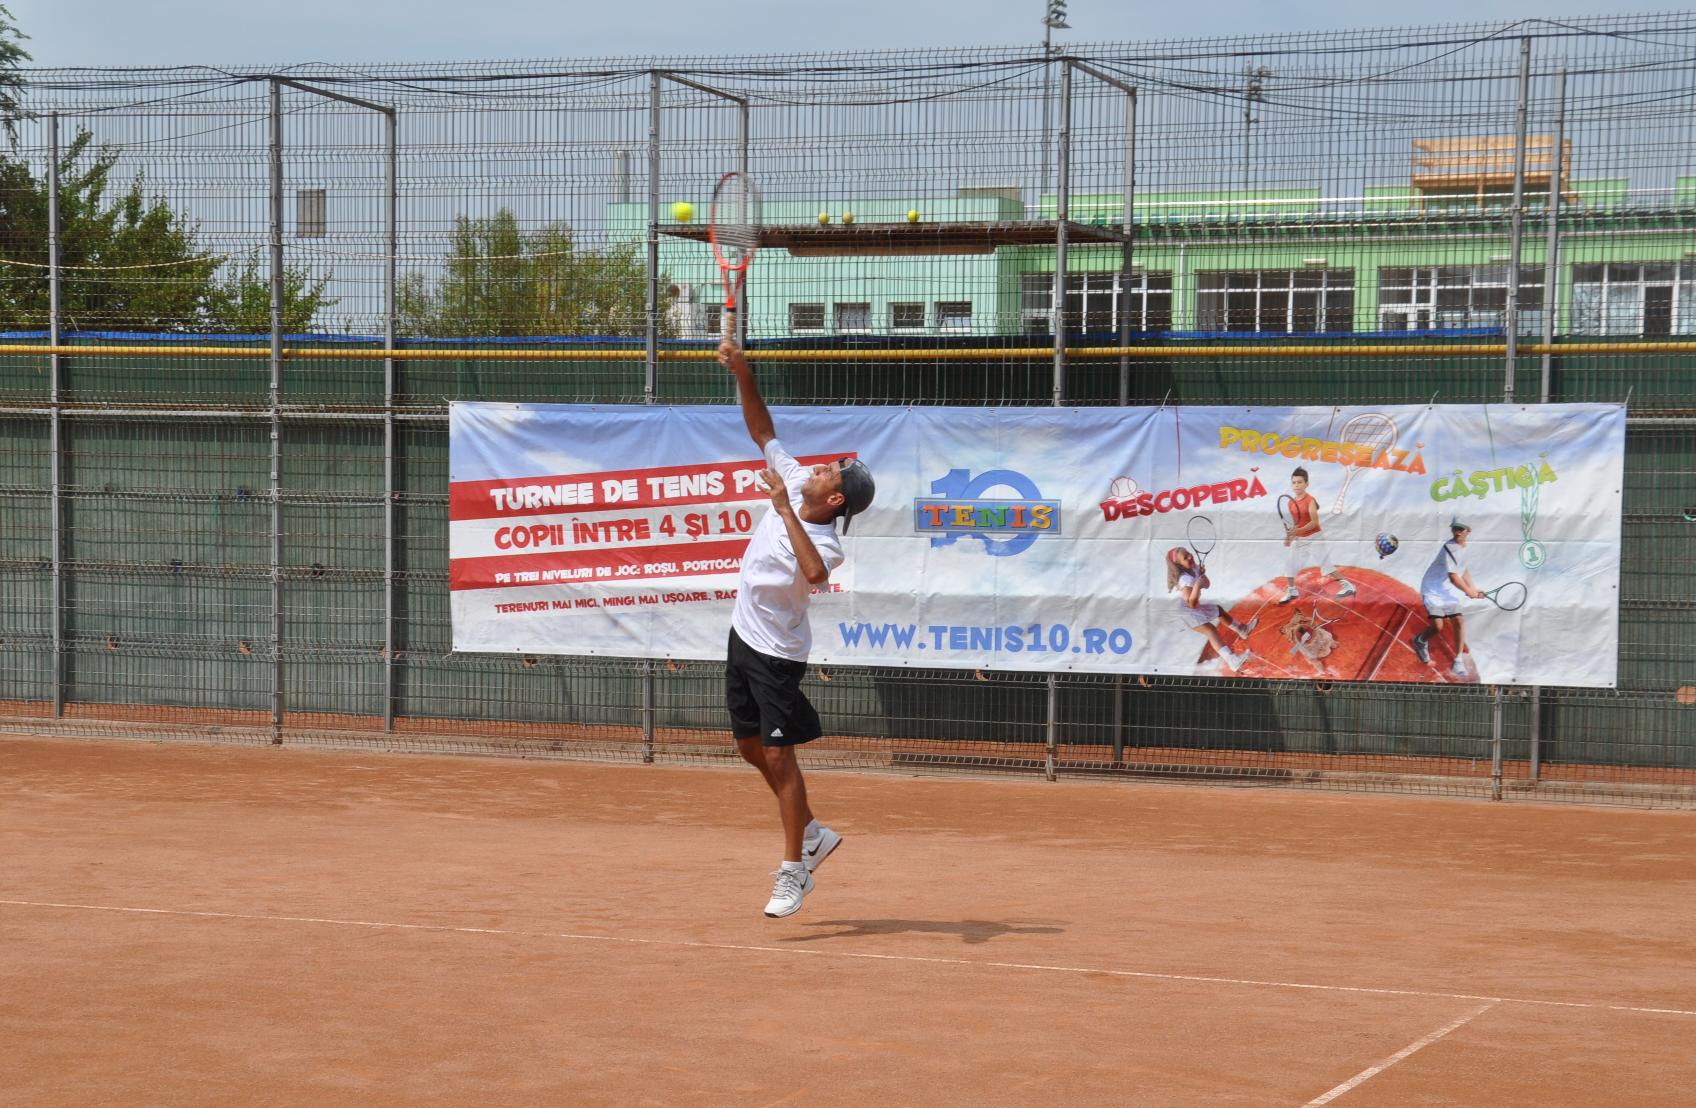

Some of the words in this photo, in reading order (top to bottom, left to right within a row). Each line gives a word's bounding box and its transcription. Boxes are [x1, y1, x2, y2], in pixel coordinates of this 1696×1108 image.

[1219, 426, 1427, 475] PROGRESEAZĂ
[490, 482, 594, 510] TURNEE
[602, 478, 639, 503] DE
[646, 470, 724, 499] TENIS
[1099, 466, 1268, 521] DESCOPERĂ
[494, 524, 564, 550] COPII
[572, 517, 651, 545] ÎNTRE
[659, 514, 676, 537] 4
[684, 513, 710, 541] ȘI
[718, 509, 752, 533] 10
[922, 504, 1053, 529] TENIS
[495, 572, 511, 583] PE
[515, 569, 539, 583] TREI
[542, 567, 592, 581] NIVELURI
[596, 566, 612, 577] DE
[615, 564, 640, 576] JOC:
[494, 601, 549, 613] TERENURI
[552, 599, 571, 609] MAI
[603, 595, 635, 607] MINGI
[638, 594, 659, 605] MAI
[838, 622, 1132, 655] WWW.TENIS10.RO
